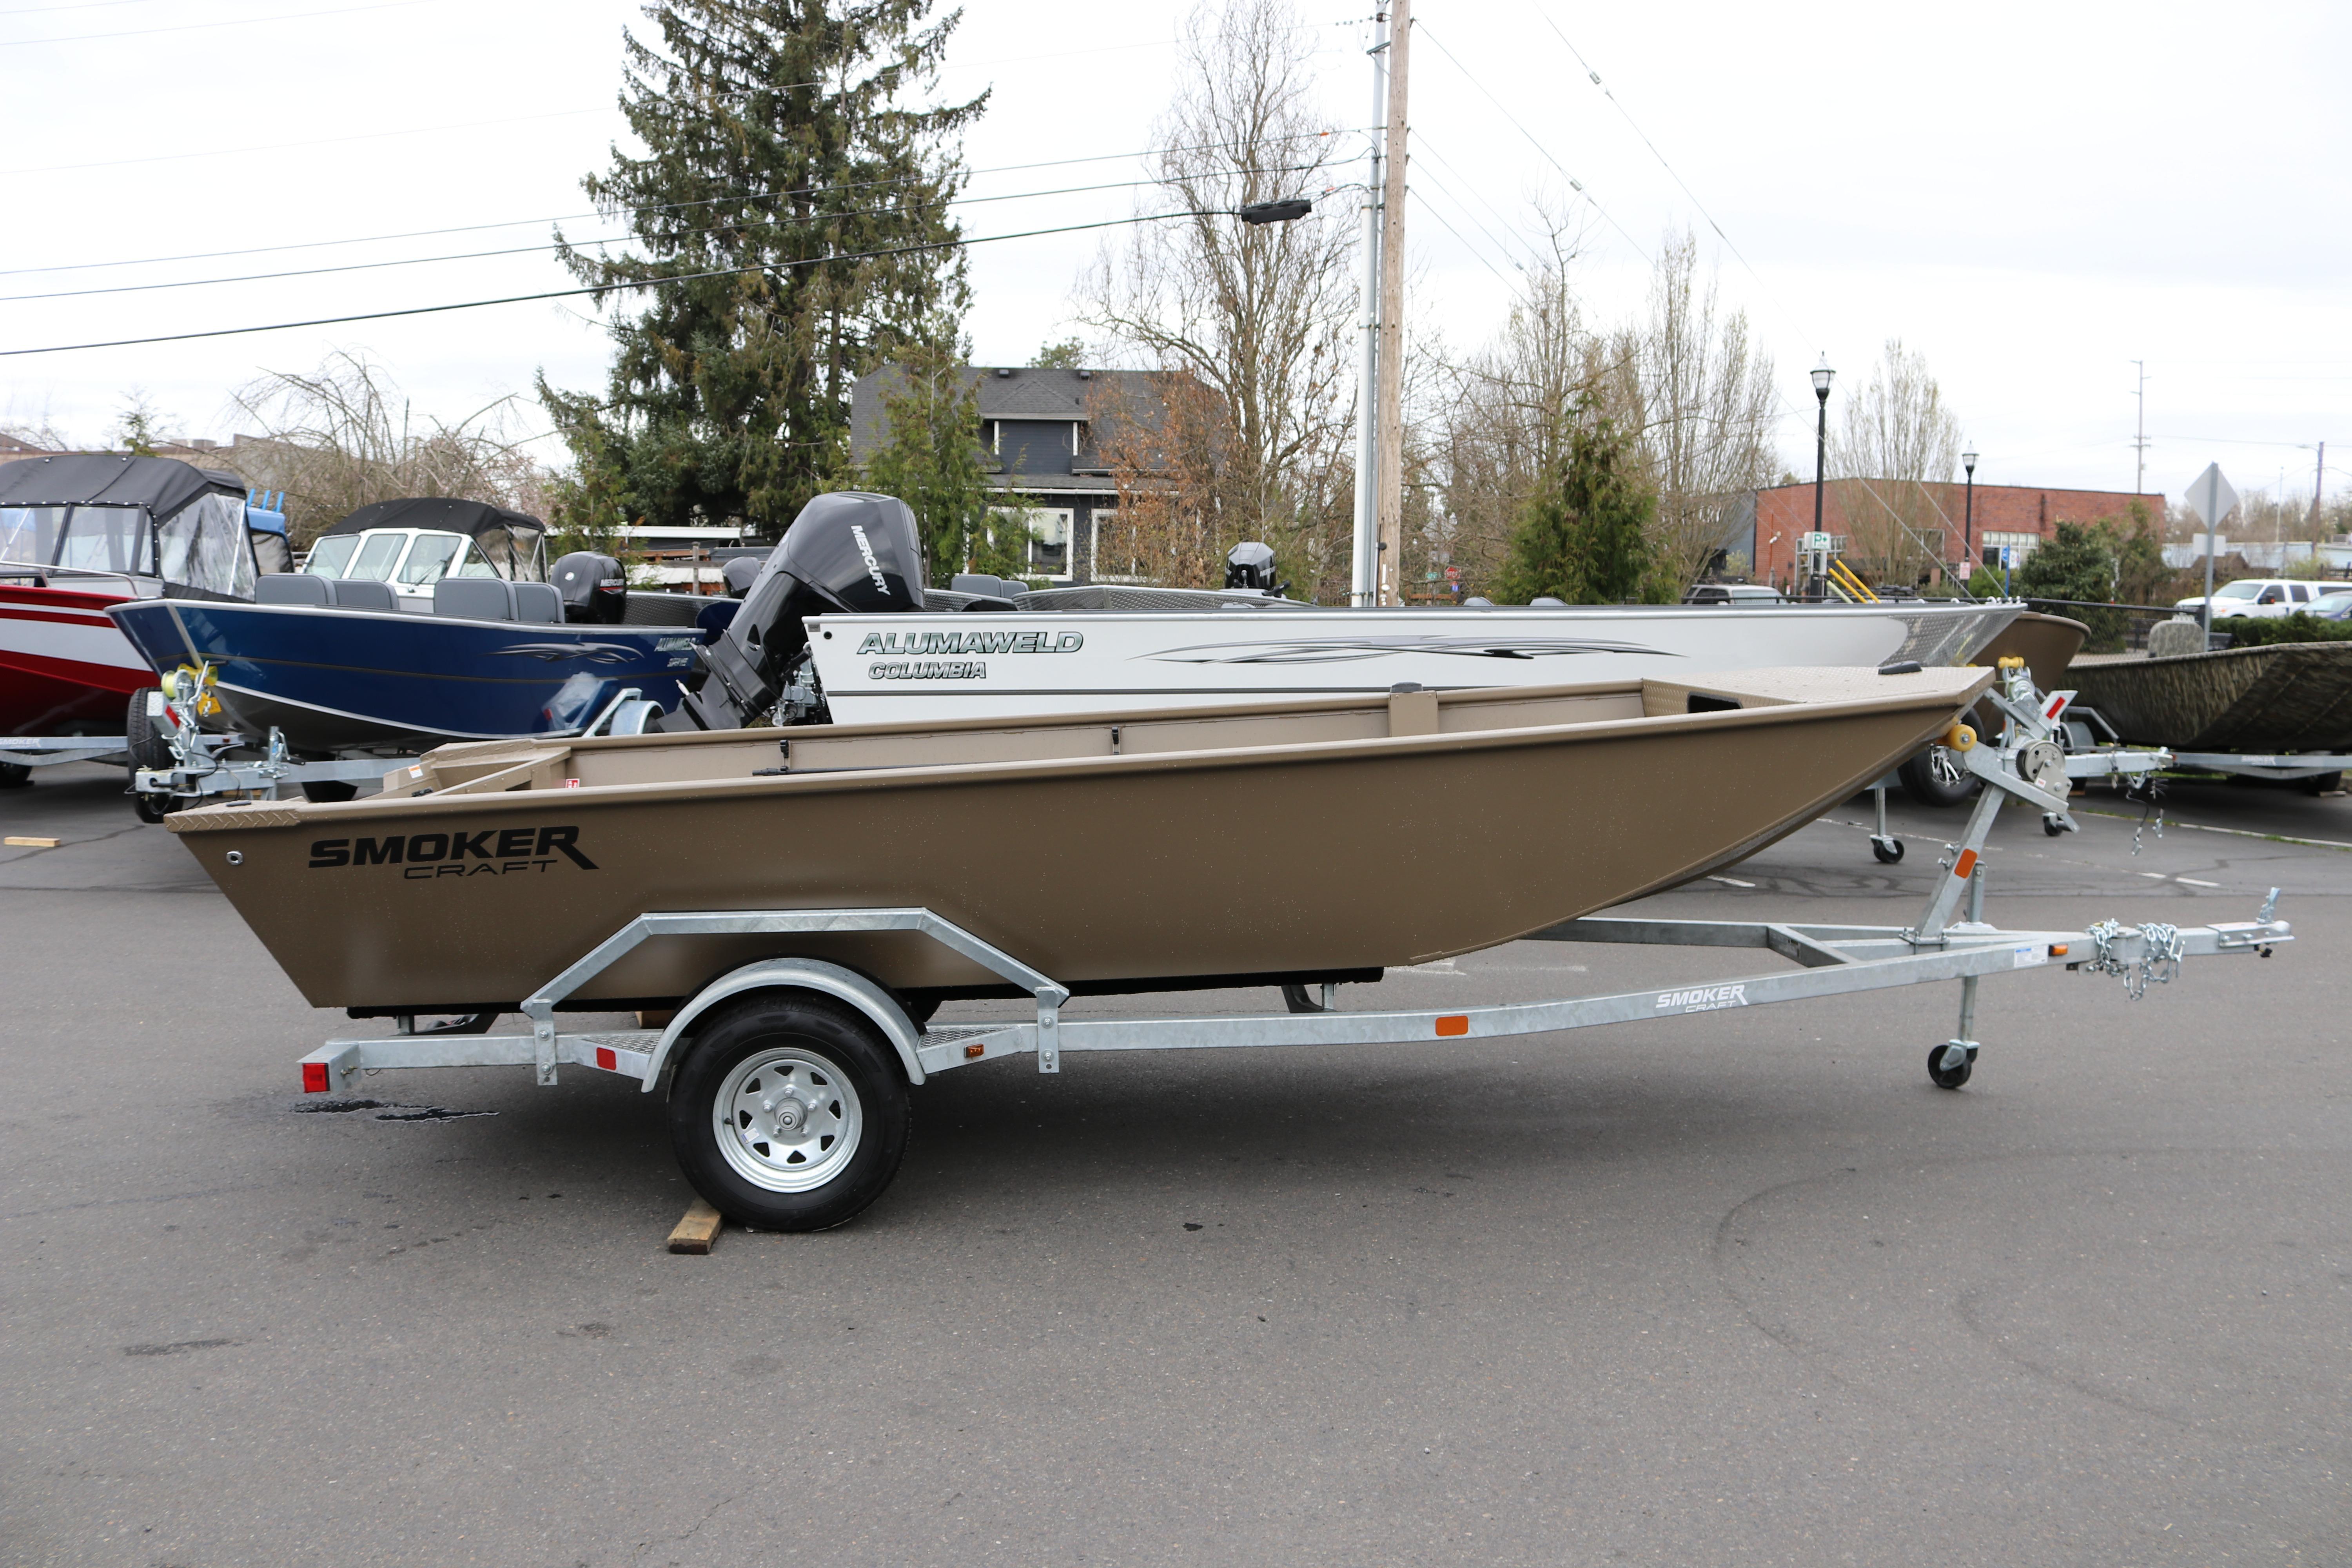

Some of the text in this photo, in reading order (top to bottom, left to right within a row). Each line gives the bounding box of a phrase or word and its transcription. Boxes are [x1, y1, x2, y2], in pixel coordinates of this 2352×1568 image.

[1815, 534, 1822, 546] P
[851, 525, 891, 595] MERCURY
[856, 632, 1083, 654] ALUMAWELD
[868, 662, 986, 679] COLUMBIA
[308, 826, 599, 870] SMOKER
[404, 860, 557, 879] CRAFT
[1656, 984, 1748, 1008] SMOKER
[1685, 1000, 1736, 1013] CRAFT
